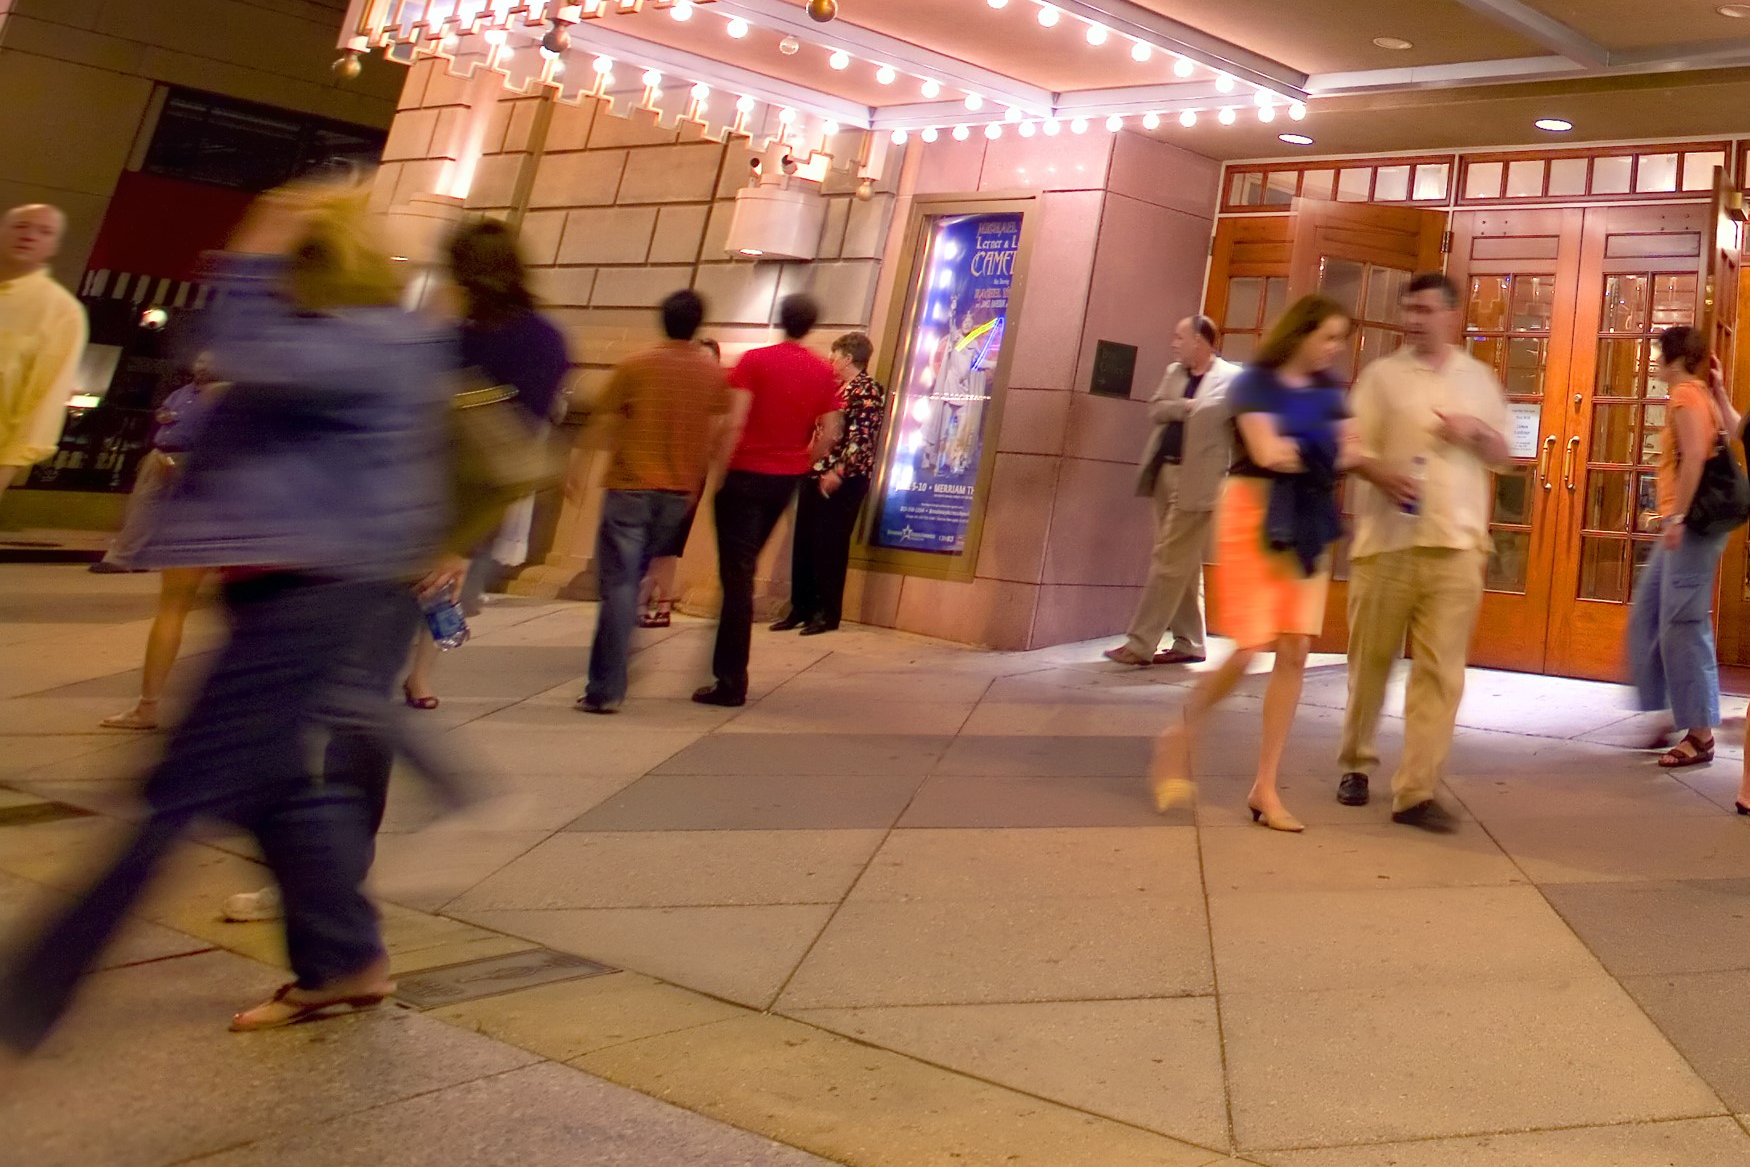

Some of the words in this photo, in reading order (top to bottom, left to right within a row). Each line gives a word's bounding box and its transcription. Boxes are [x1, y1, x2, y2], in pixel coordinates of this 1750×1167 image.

[976, 236, 1003, 249] Lerner
[971, 250, 1018, 277] CAMEL
[934, 484, 966, 494] MERRIAM
